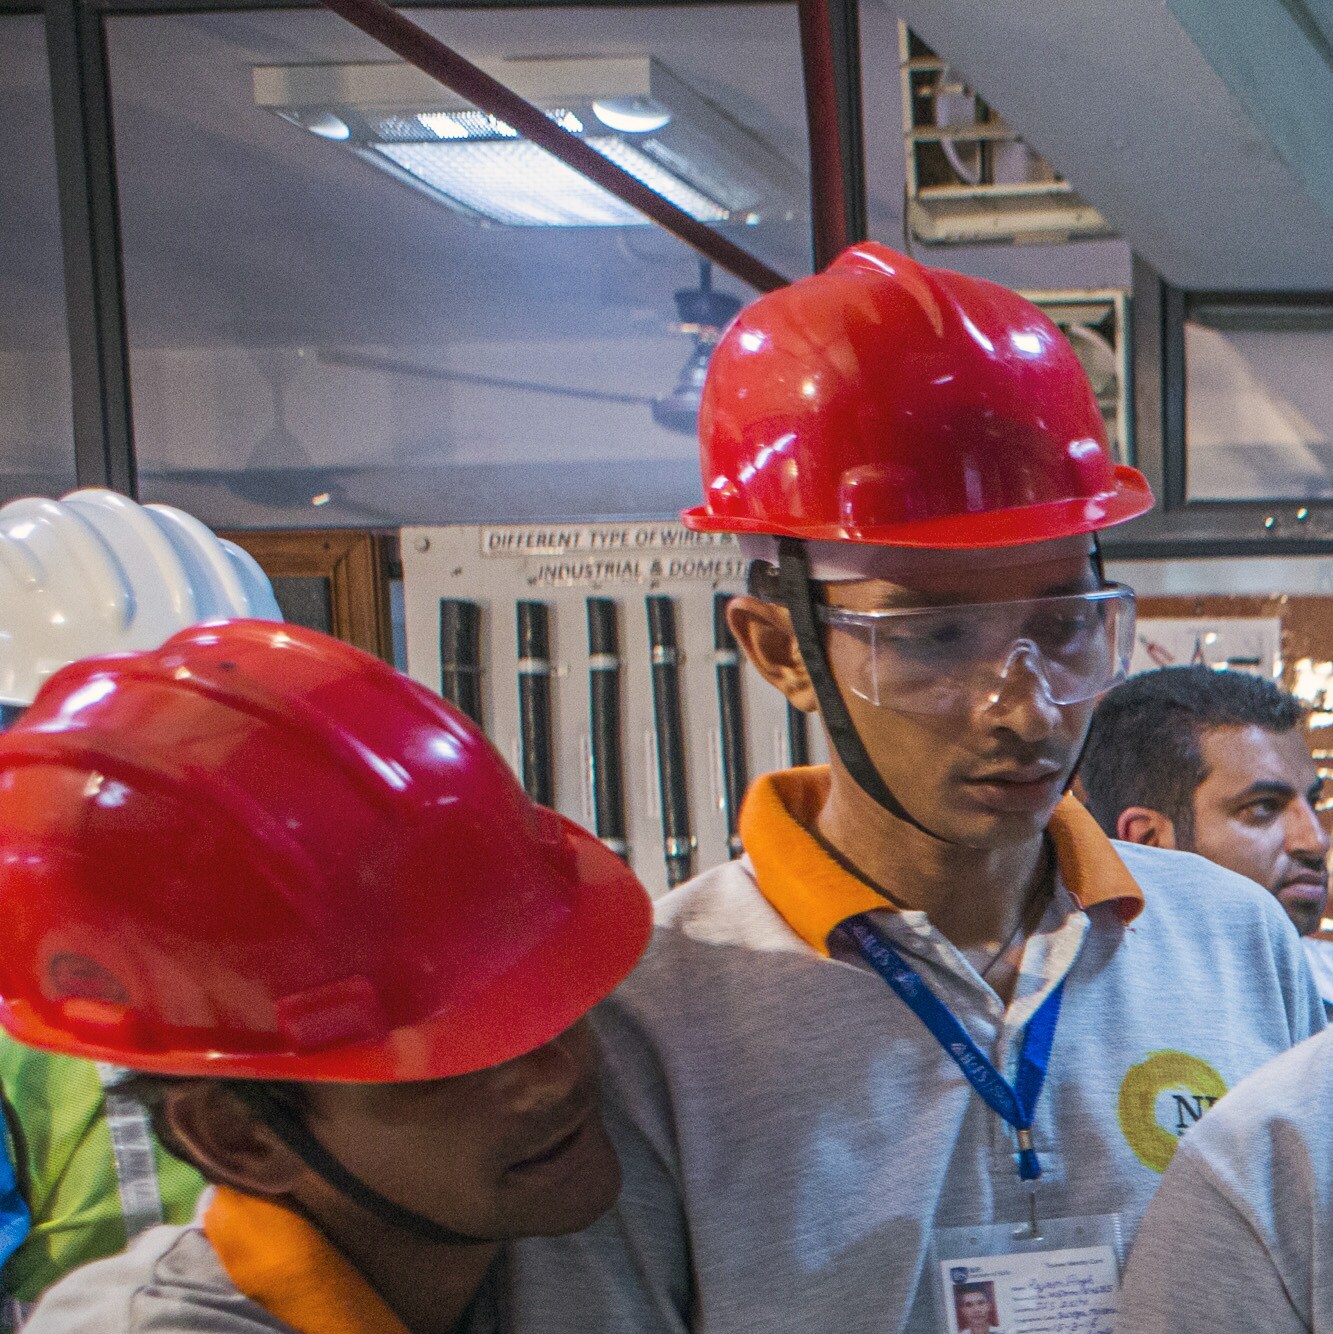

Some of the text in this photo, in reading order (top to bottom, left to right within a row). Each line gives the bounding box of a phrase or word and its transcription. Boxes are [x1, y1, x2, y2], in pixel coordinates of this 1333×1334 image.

[488, 530, 581, 550] DIFFERENT
[589, 529, 628, 547] TYPE
[635, 529, 656, 547] OF
[658, 528, 714, 547] WIRES
[536, 560, 640, 581] INDUSTRIAL
[650, 559, 663, 577] &
